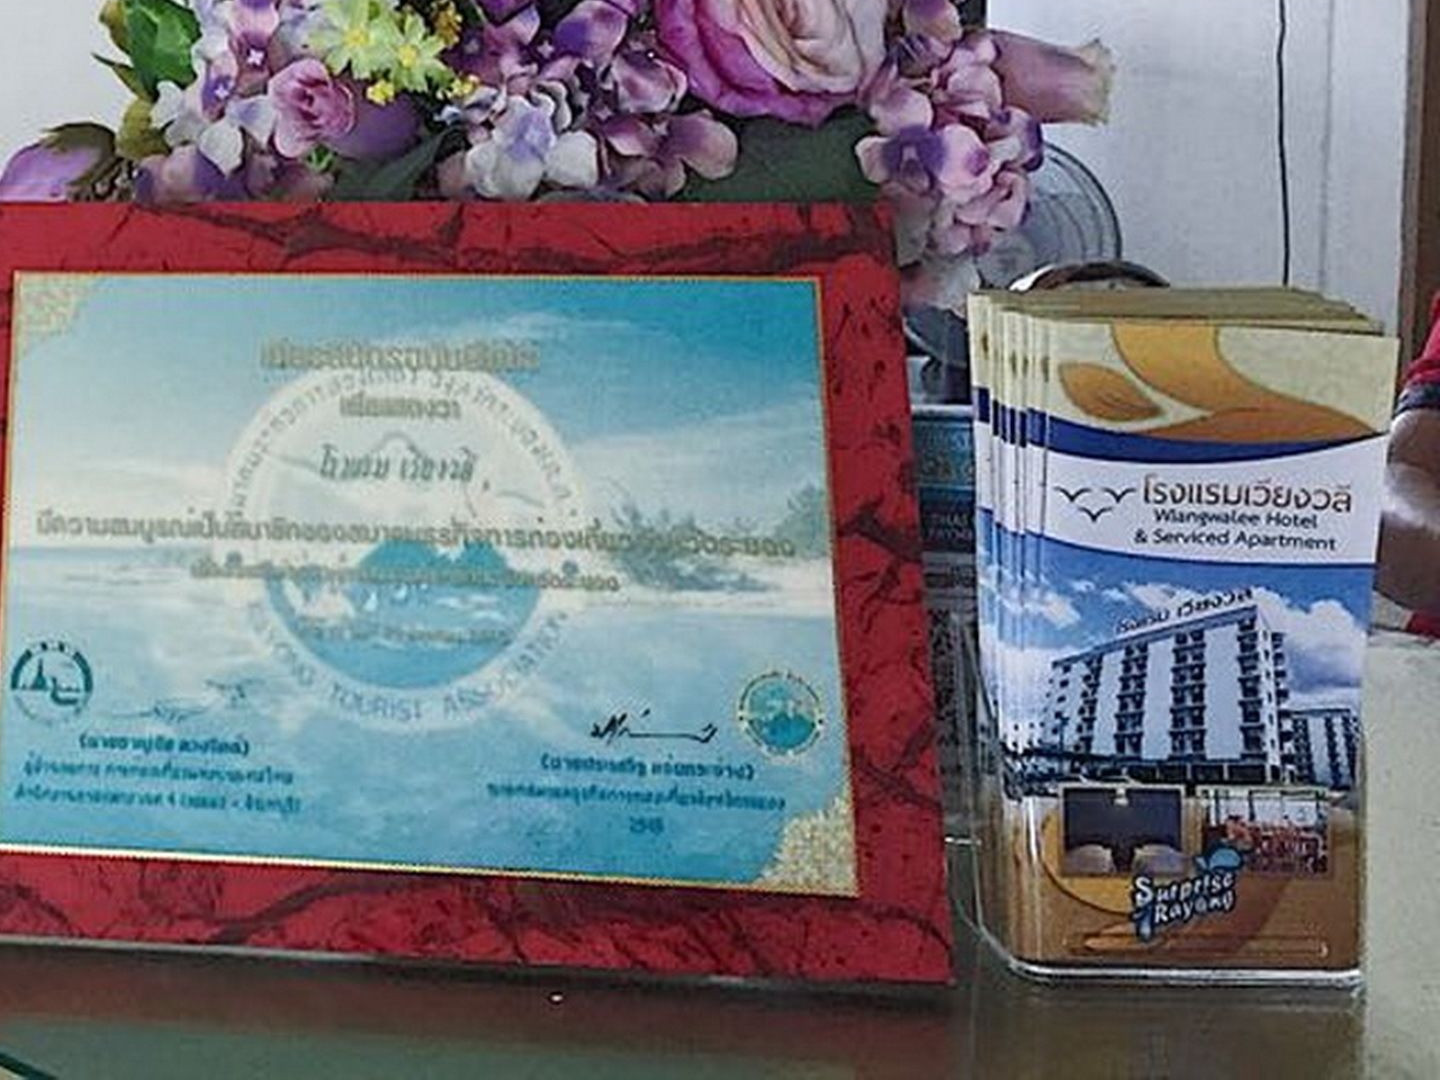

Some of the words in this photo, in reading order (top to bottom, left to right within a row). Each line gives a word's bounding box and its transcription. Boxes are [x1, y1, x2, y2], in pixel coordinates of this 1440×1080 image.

[1142, 473, 1353, 514] โรงแรมเวียงวลี
[1153, 508, 1261, 528] Wiangwalee
[1265, 511, 1318, 529] Hotel
[1134, 529, 1147, 544] &
[1153, 528, 1230, 545] Serviced
[1235, 531, 1336, 552] Apartment
[1134, 870, 1234, 906] Surprise
[1153, 894, 1234, 925] Rayong
